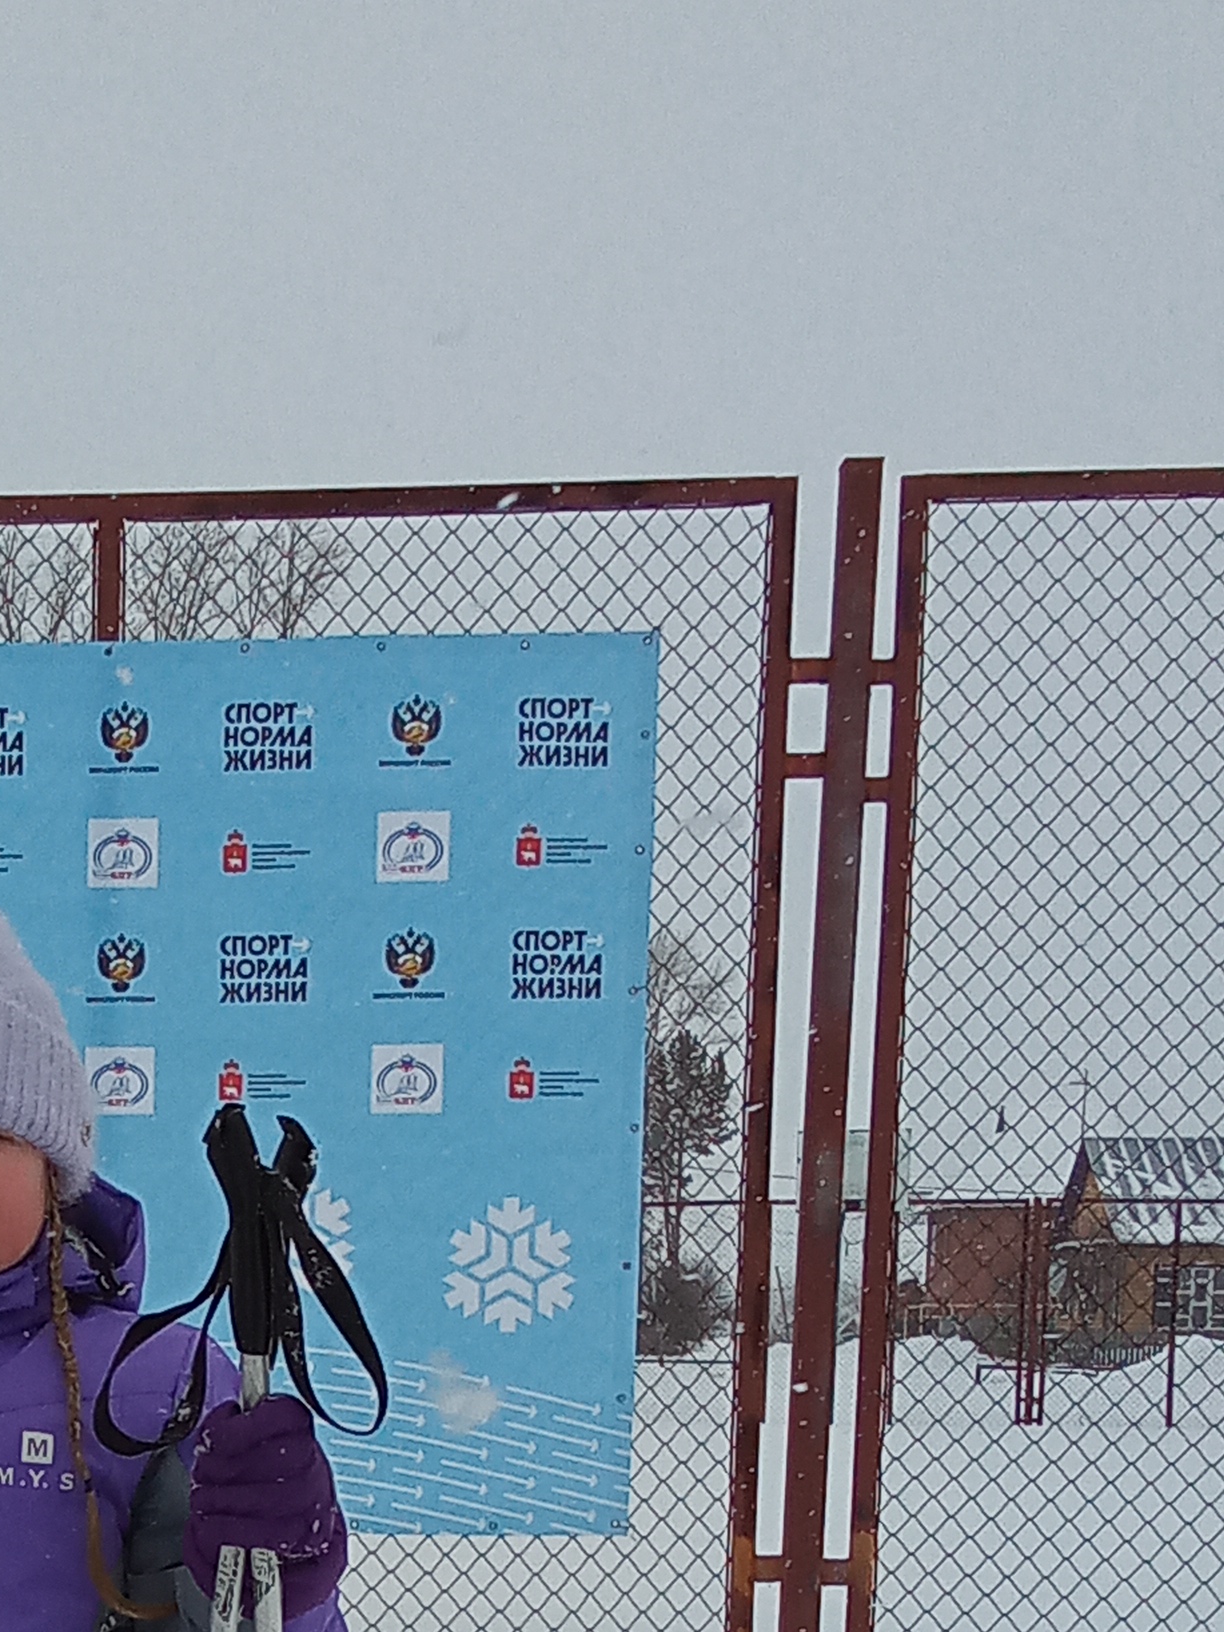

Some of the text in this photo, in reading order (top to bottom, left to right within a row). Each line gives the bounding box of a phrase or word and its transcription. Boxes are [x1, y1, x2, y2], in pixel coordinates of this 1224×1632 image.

[224, 702, 298, 724] СПОРТ
[519, 697, 594, 719] СПОРТ
[224, 725, 312, 748] НОРМА
[519, 721, 609, 742] НОРМА
[223, 749, 312, 772] ЖИЗНИ
[517, 744, 608, 767] ЖИЗНИ
[220, 934, 293, 956] СПОРТ
[512, 930, 588, 951] СПОРТ
[220, 957, 307, 980] НОРМА
[512, 953, 602, 975] НОРМА
[219, 981, 307, 1003] ЖИЗНИ
[511, 977, 601, 999] ЖИЗНИ
[26, 1437, 49, 1458] M
